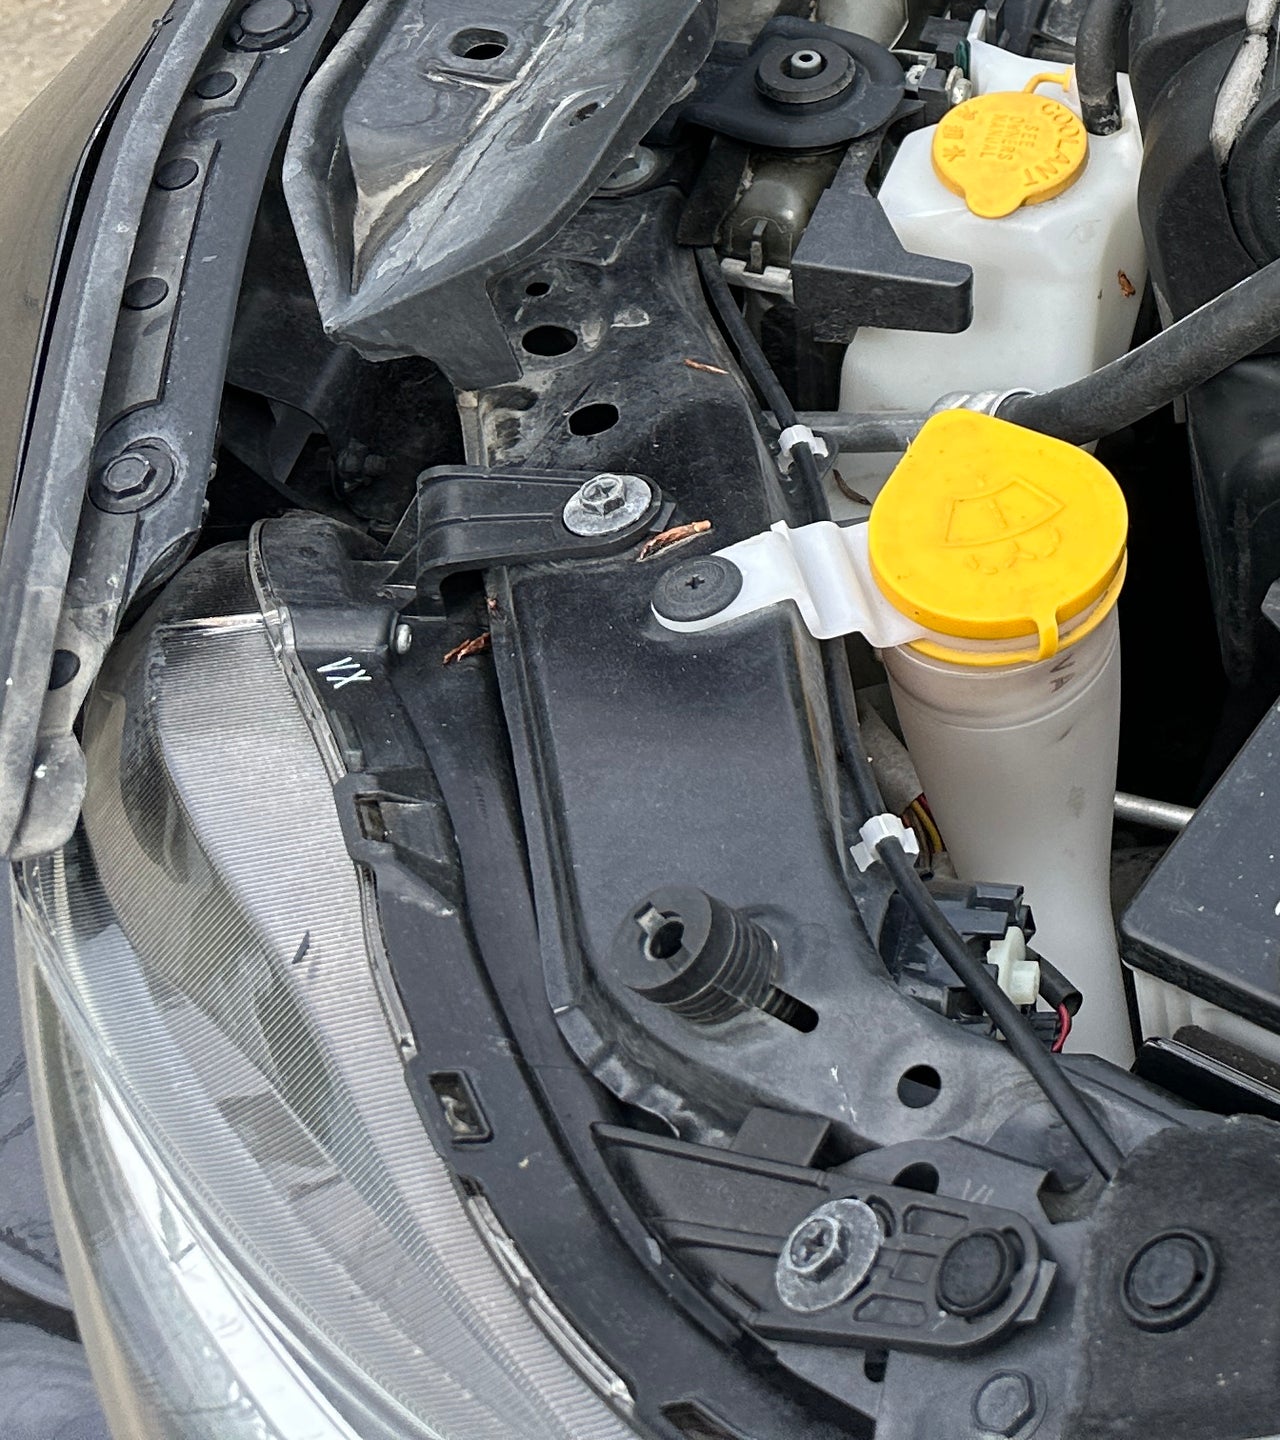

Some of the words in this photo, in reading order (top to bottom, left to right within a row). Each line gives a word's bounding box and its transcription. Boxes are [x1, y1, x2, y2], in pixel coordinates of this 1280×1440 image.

[979, 113, 1009, 159] MANUAL
[1018, 124, 1040, 148] SEE
[1024, 102, 1080, 187] COOLANT
